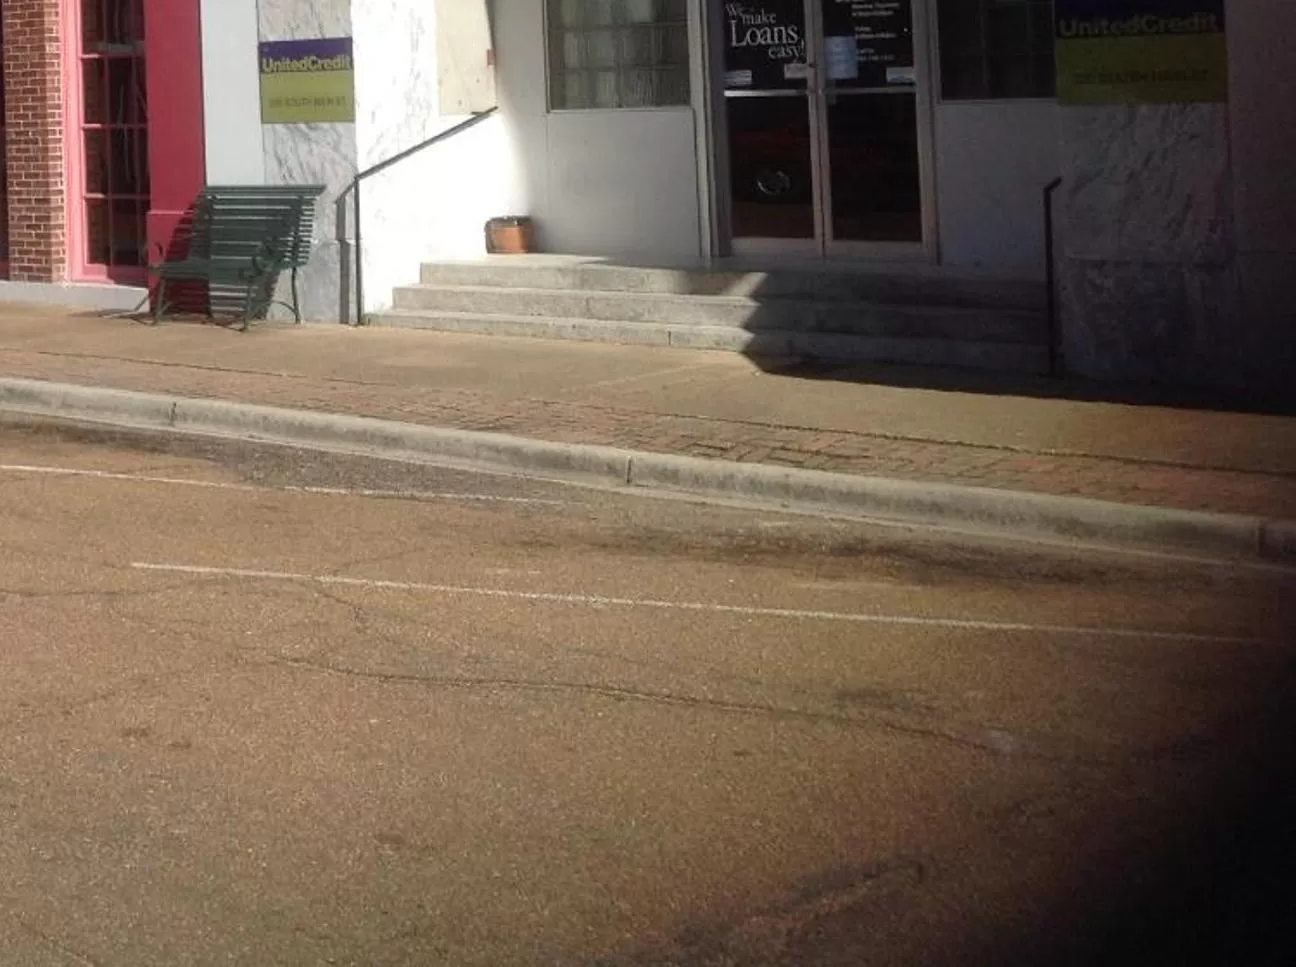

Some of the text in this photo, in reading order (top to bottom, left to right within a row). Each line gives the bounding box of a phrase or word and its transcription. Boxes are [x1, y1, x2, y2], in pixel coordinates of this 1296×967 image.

[741, 8, 777, 25] make
[1059, 12, 1219, 37] UnitedCredit
[728, 20, 799, 47] Loans
[262, 54, 352, 73] UnitedCredit
